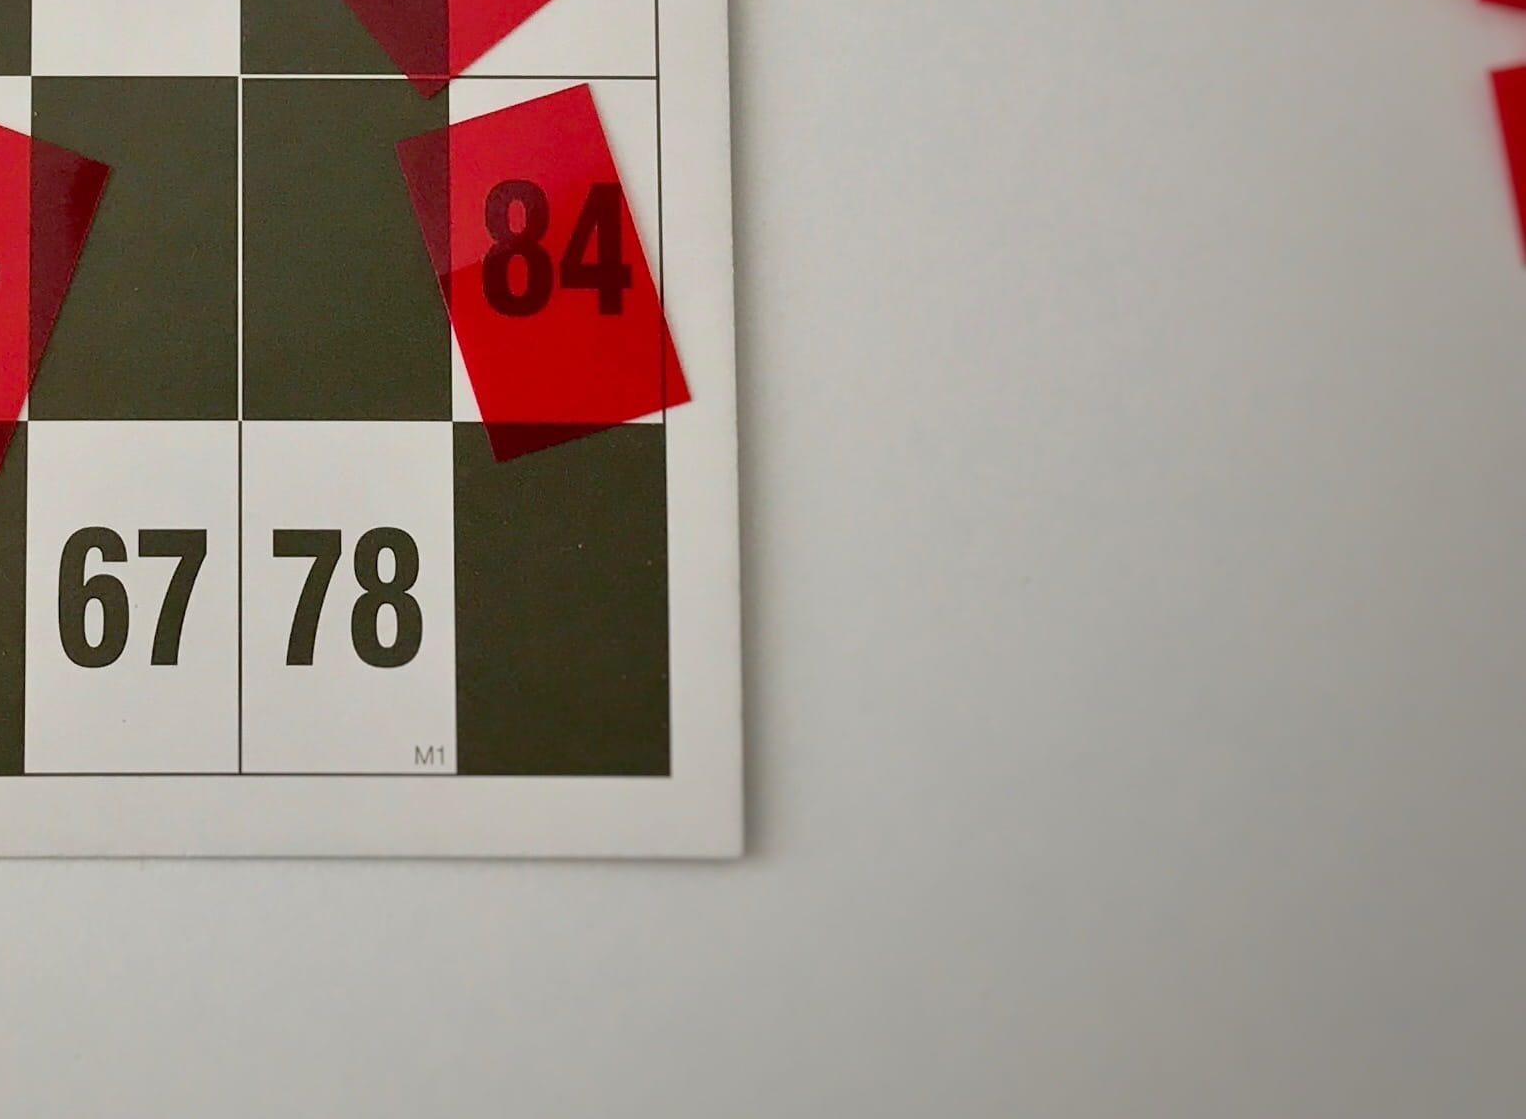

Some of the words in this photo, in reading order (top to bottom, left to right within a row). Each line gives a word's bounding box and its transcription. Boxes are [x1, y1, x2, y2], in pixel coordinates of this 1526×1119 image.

[482, 180, 632, 317] 84
[58, 527, 207, 668] 67
[273, 527, 422, 668] 78
[414, 745, 445, 766] M1
